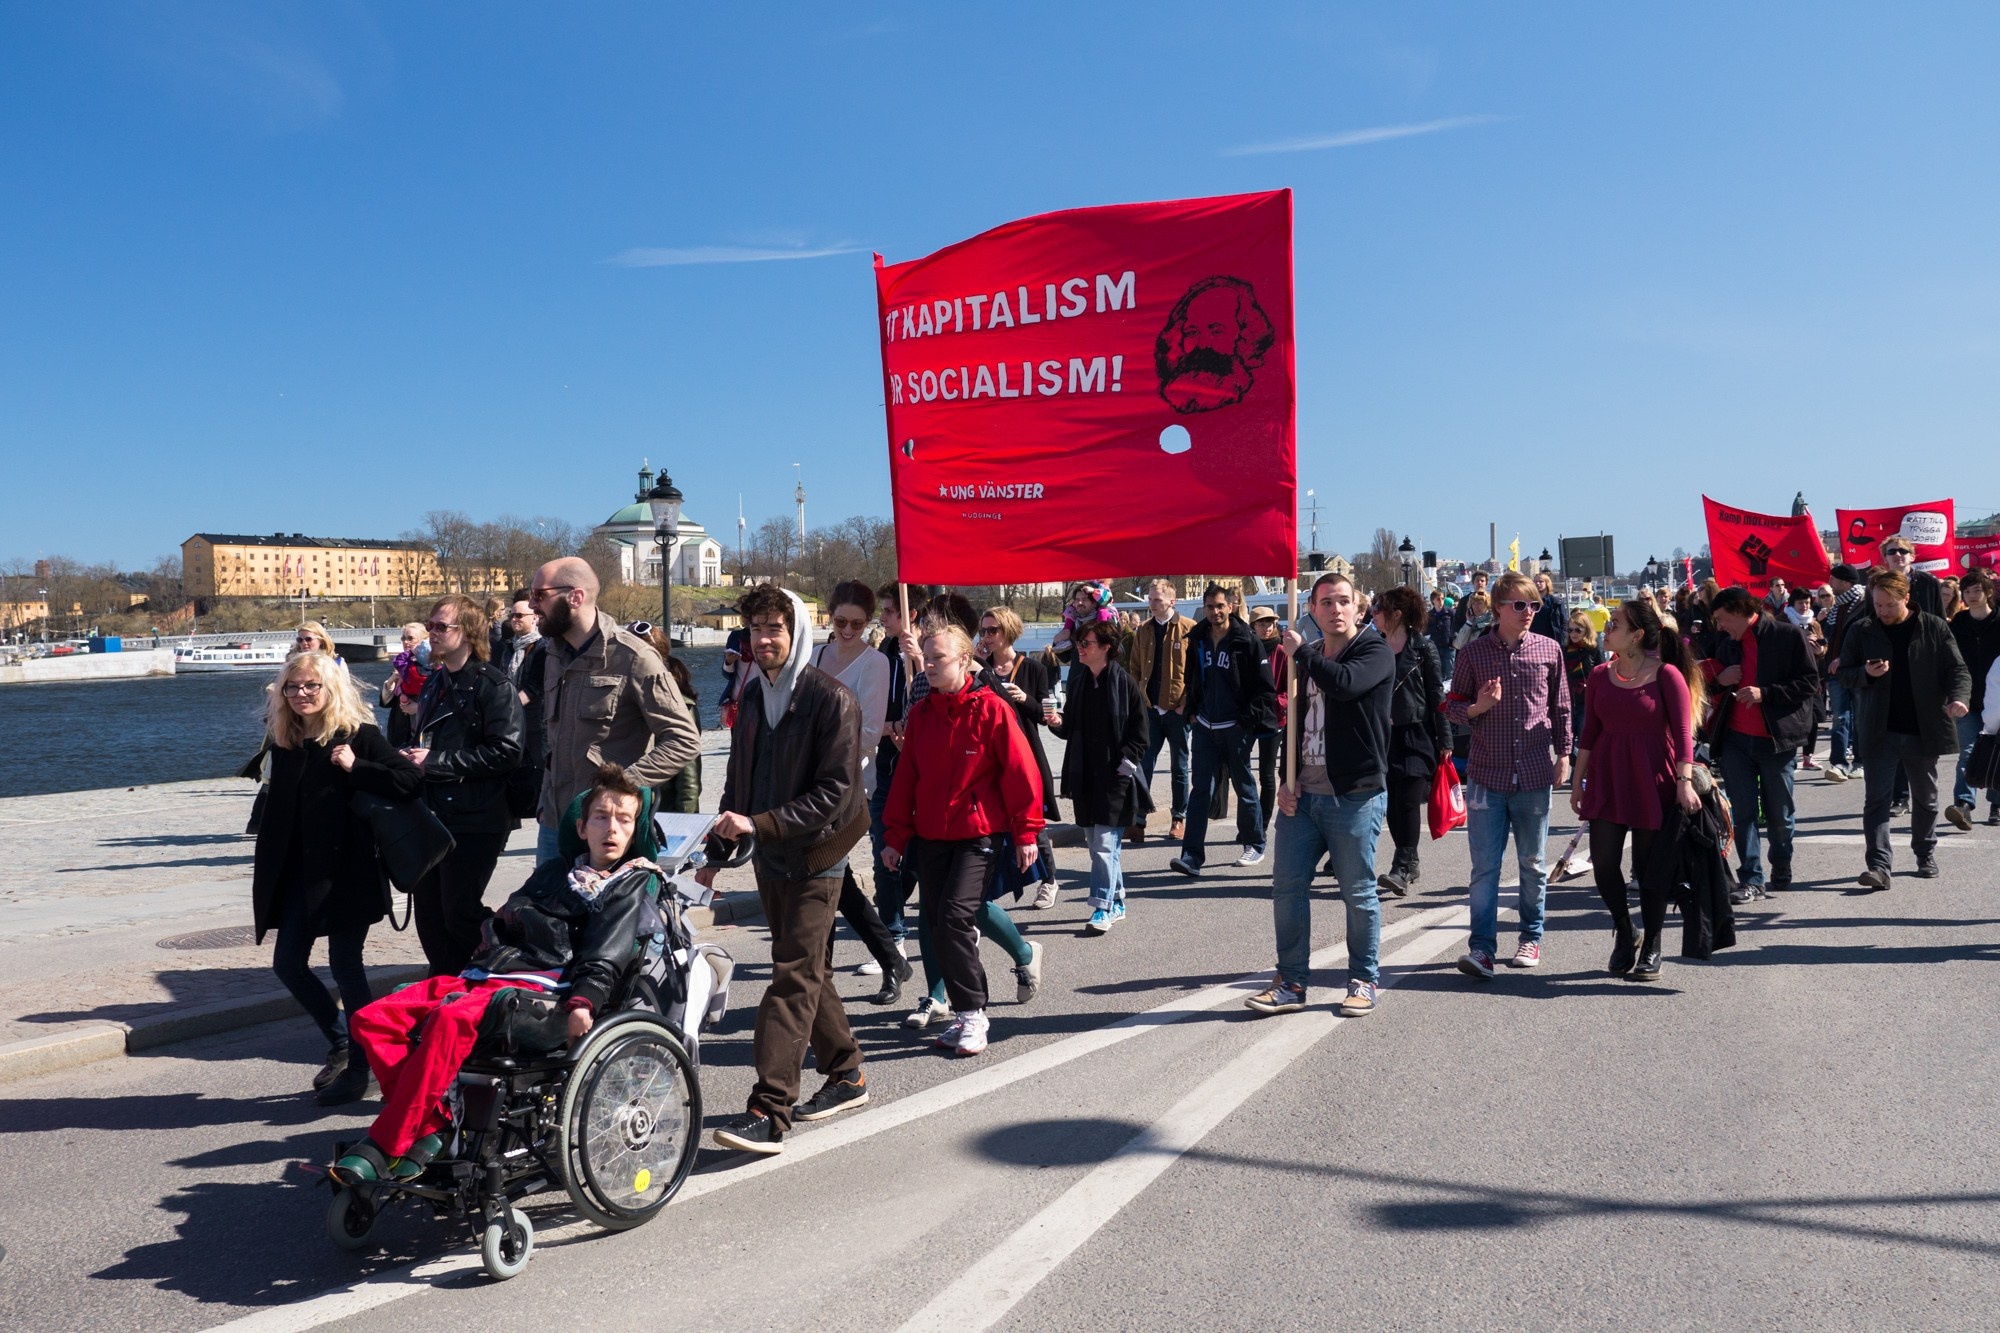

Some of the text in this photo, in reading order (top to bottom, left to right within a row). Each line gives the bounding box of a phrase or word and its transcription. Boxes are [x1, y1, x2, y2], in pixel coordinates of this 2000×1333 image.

[902, 271, 1136, 340] KAPITALISM
[908, 355, 1124, 405] SOCIALISM!
[950, 480, 1044, 500] UNG VÄNSTER
[1907, 515, 1926, 523] RÄTT
